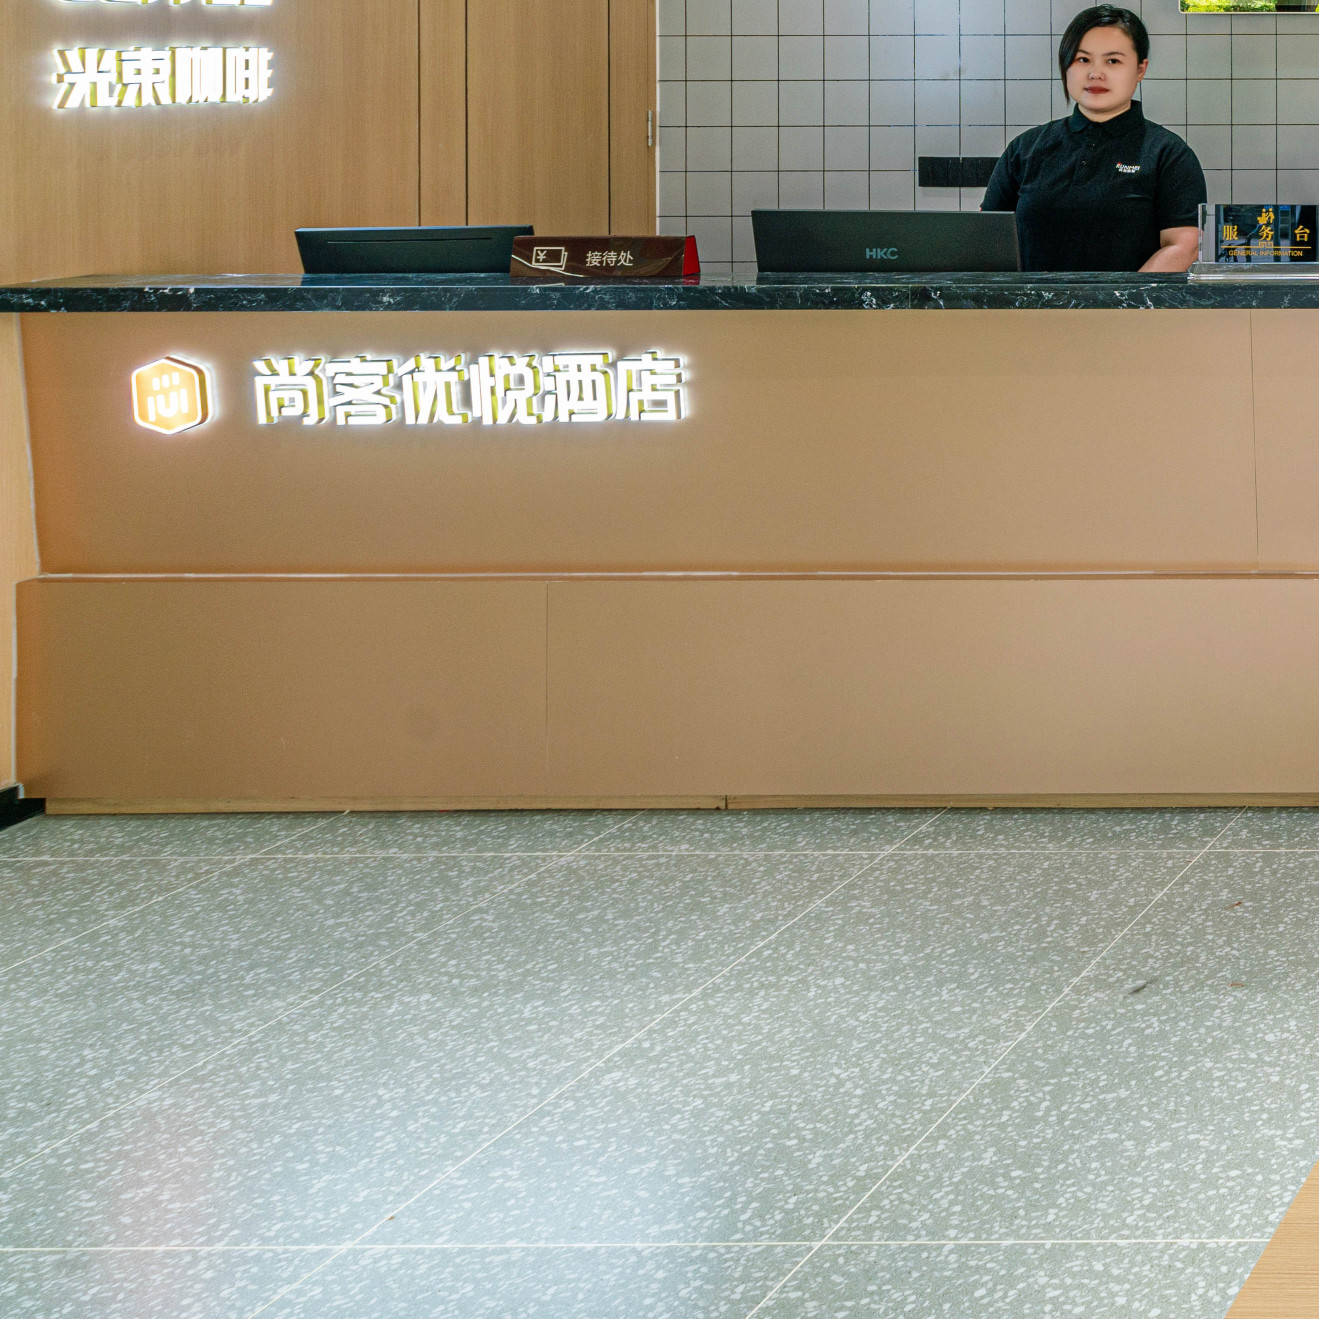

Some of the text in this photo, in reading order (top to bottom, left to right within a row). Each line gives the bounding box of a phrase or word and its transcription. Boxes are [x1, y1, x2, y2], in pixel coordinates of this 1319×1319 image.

[54, 46, 273, 110] 光束咖啡
[1222, 225, 1310, 242] 服务台
[585, 250, 634, 267] 接待处
[865, 247, 898, 260] HKC
[253, 350, 687, 425] 尚客优悦酒店
